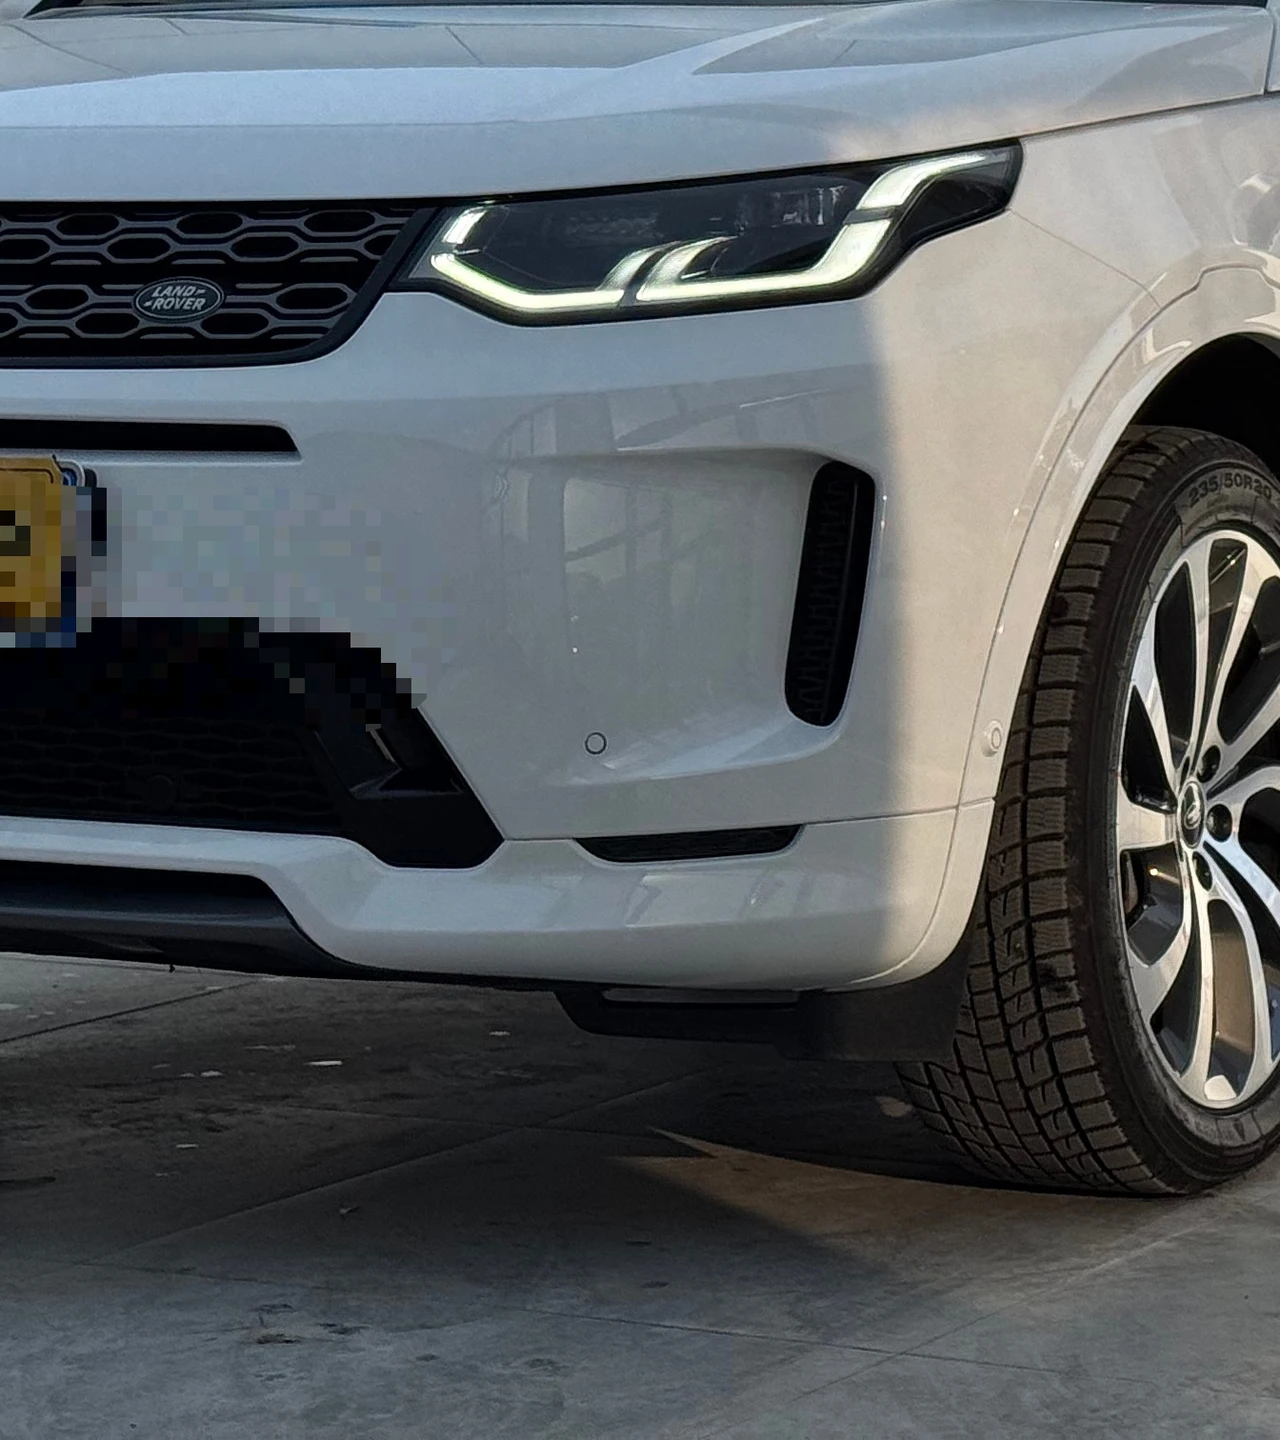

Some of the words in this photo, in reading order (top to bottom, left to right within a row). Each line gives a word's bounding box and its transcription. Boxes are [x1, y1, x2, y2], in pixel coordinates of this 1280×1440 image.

[151, 284, 196, 298] LAND
[151, 297, 207, 311] ROVER
[1187, 472, 1273, 509] 235/50R20
